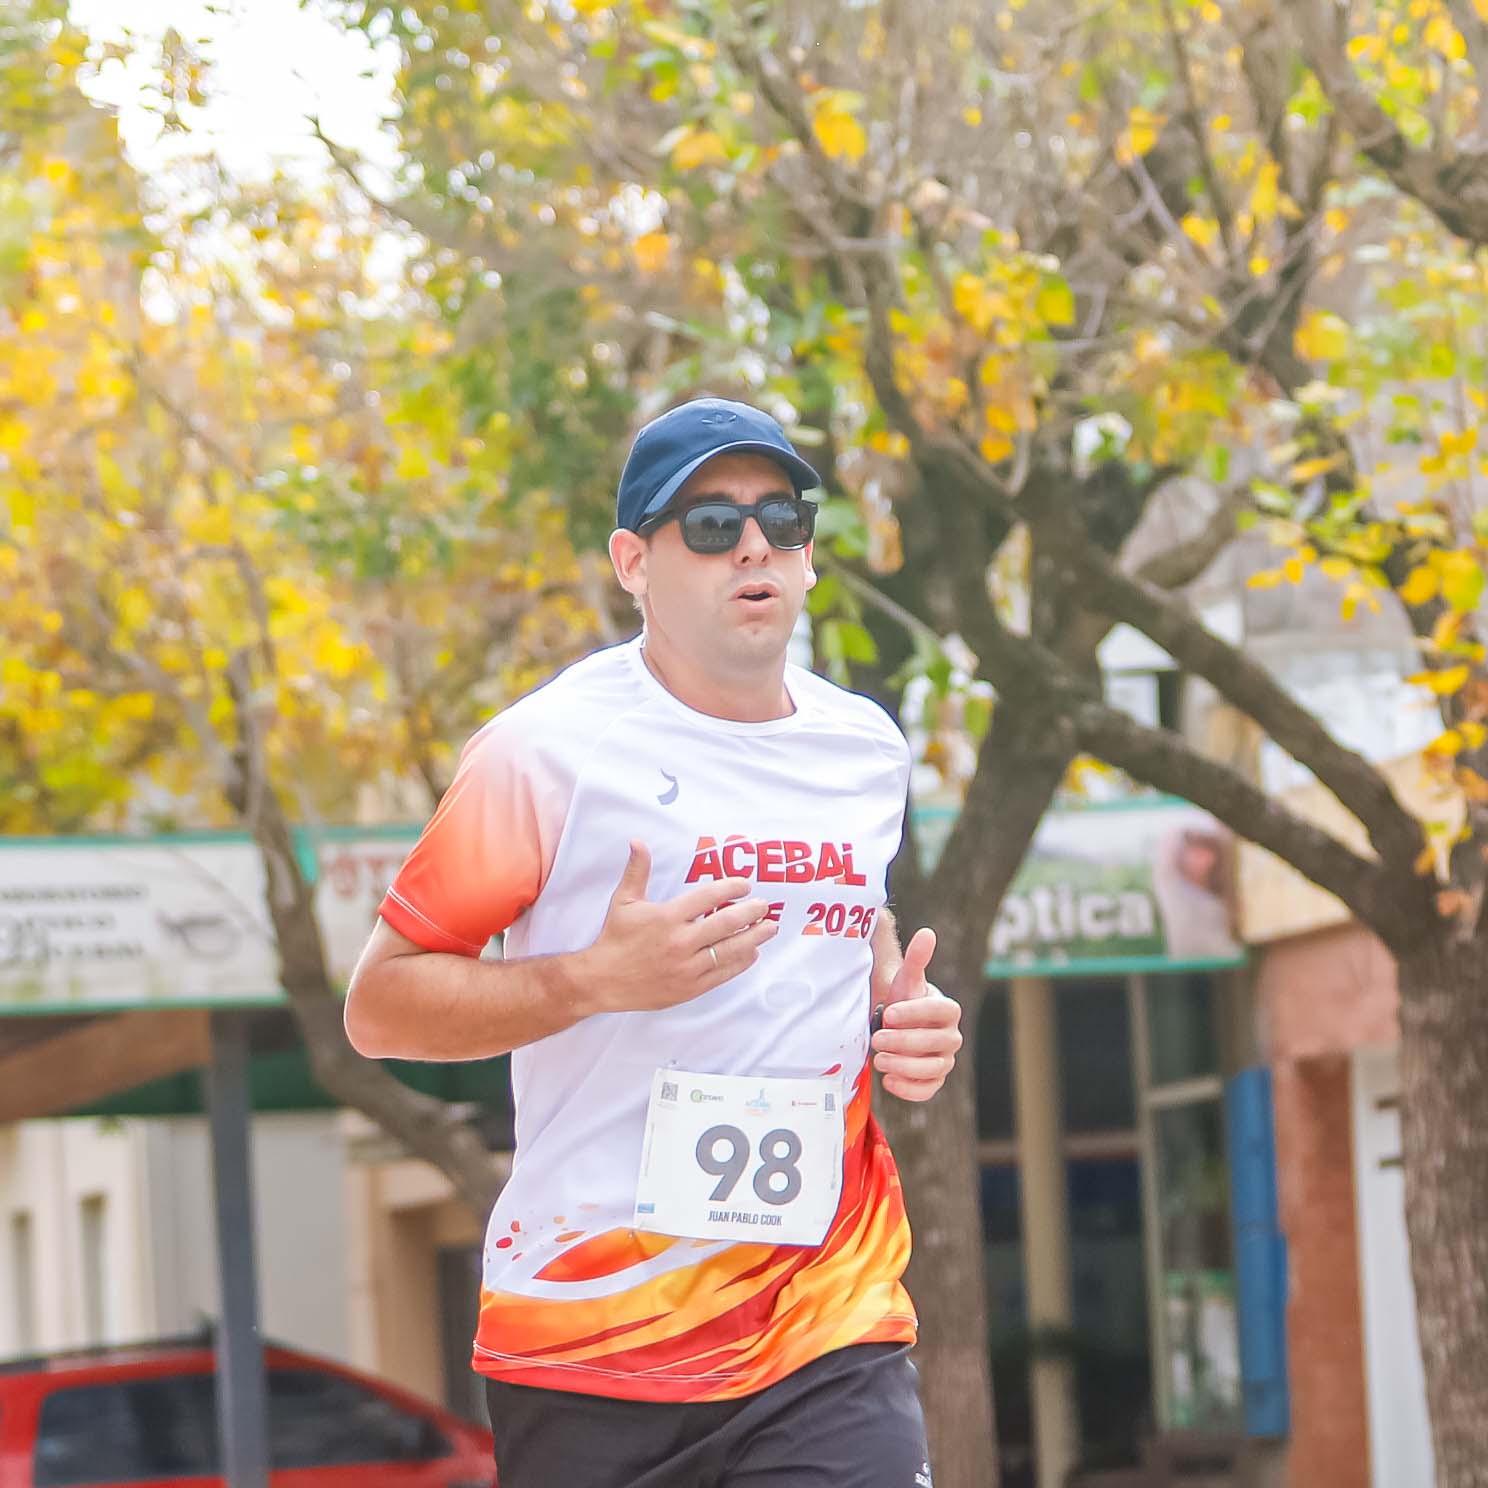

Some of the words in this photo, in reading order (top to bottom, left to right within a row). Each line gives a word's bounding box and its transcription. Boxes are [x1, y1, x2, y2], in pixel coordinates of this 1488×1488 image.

[684, 834, 867, 887] ACEBAL
[801, 902, 876, 939] 2026
[991, 881, 1155, 956] ptica
[695, 1124, 802, 1206] 98
[708, 1210, 730, 1222] JUAN
[731, 1211, 759, 1225] PABLO
[760, 1214, 783, 1226] COOK
